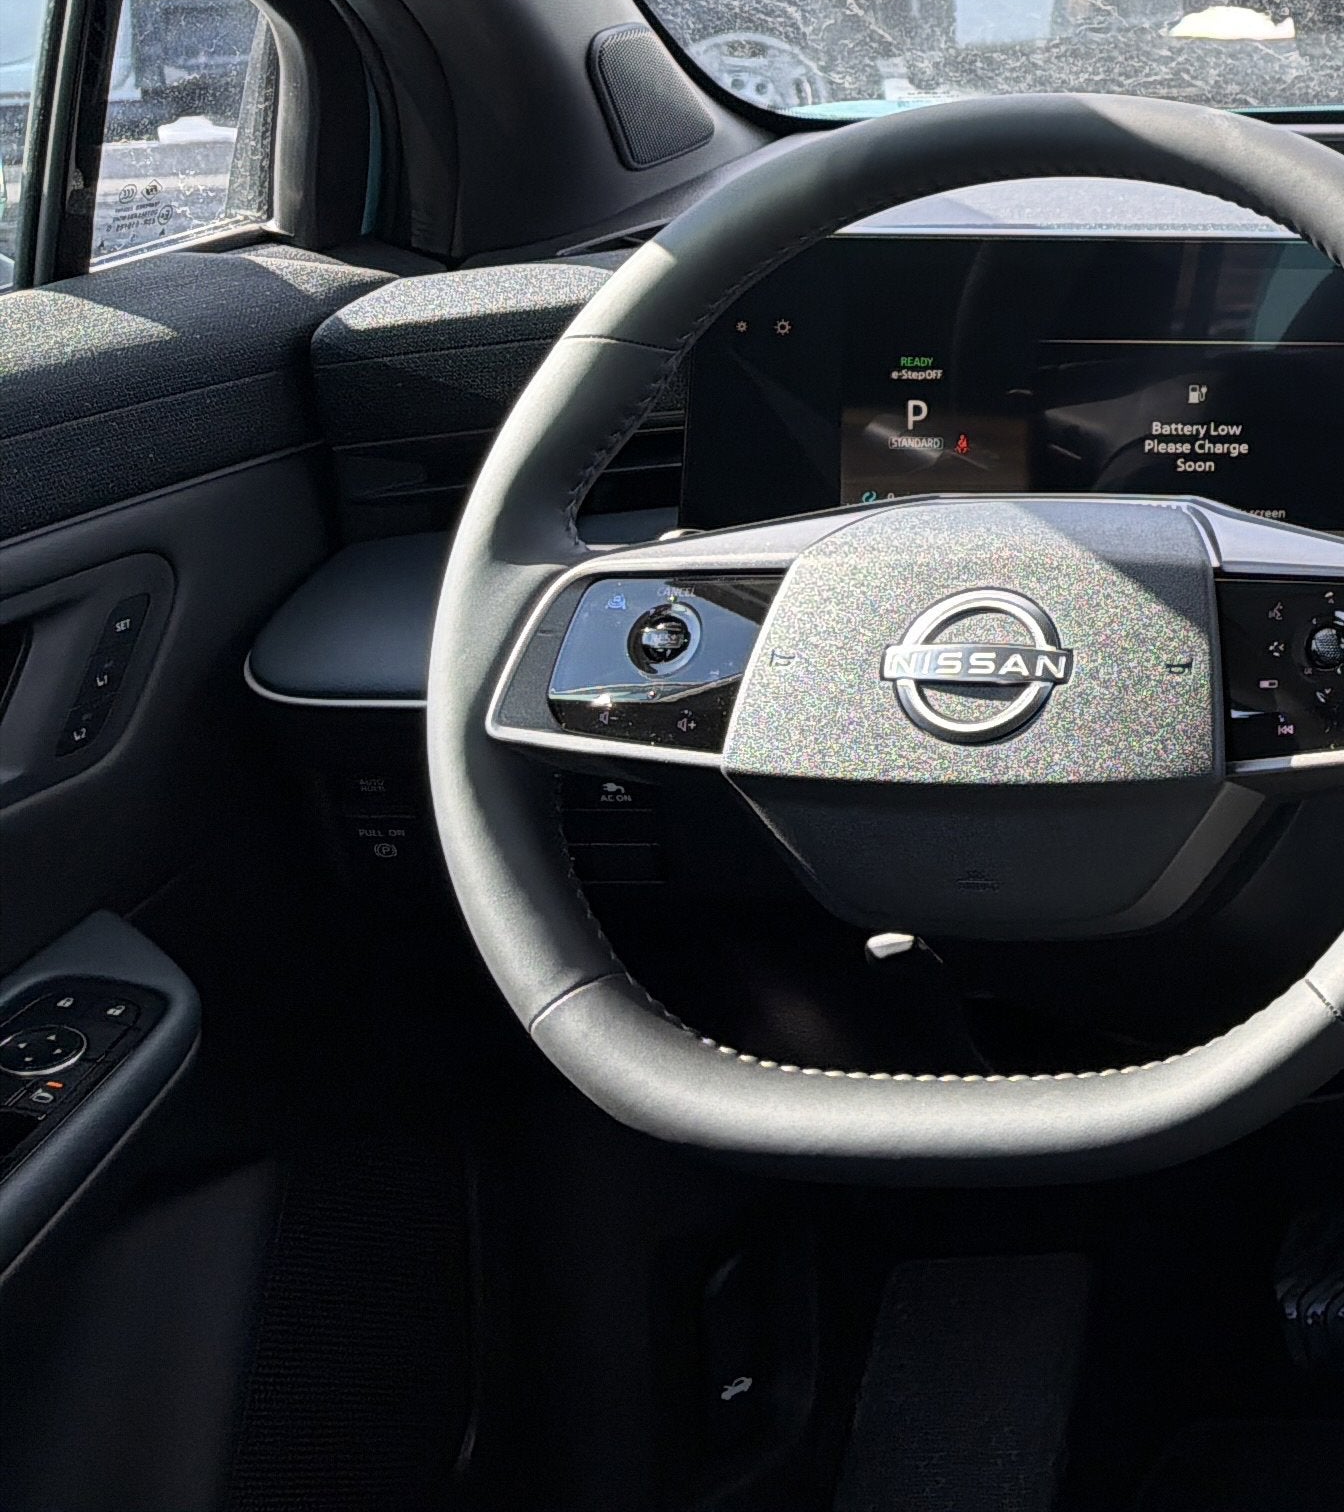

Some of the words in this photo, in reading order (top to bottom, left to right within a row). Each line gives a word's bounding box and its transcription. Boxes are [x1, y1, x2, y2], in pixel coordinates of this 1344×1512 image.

[901, 357, 933, 366] READY
[907, 399, 928, 430] P
[1152, 421, 1207, 437] Battery
[1210, 422, 1242, 435] Low
[891, 438, 940, 448] STANDARD
[1144, 439, 1191, 454] Please
[1195, 439, 1249, 457] Charge
[1176, 458, 1215, 472] Soon
[657, 586, 696, 597] CANCEL
[114, 619, 131, 632] SET
[890, 651, 1066, 679] NISSAN
[74, 728, 87, 741] L2
[358, 829, 384, 837] PULL
[388, 829, 405, 837] ON
